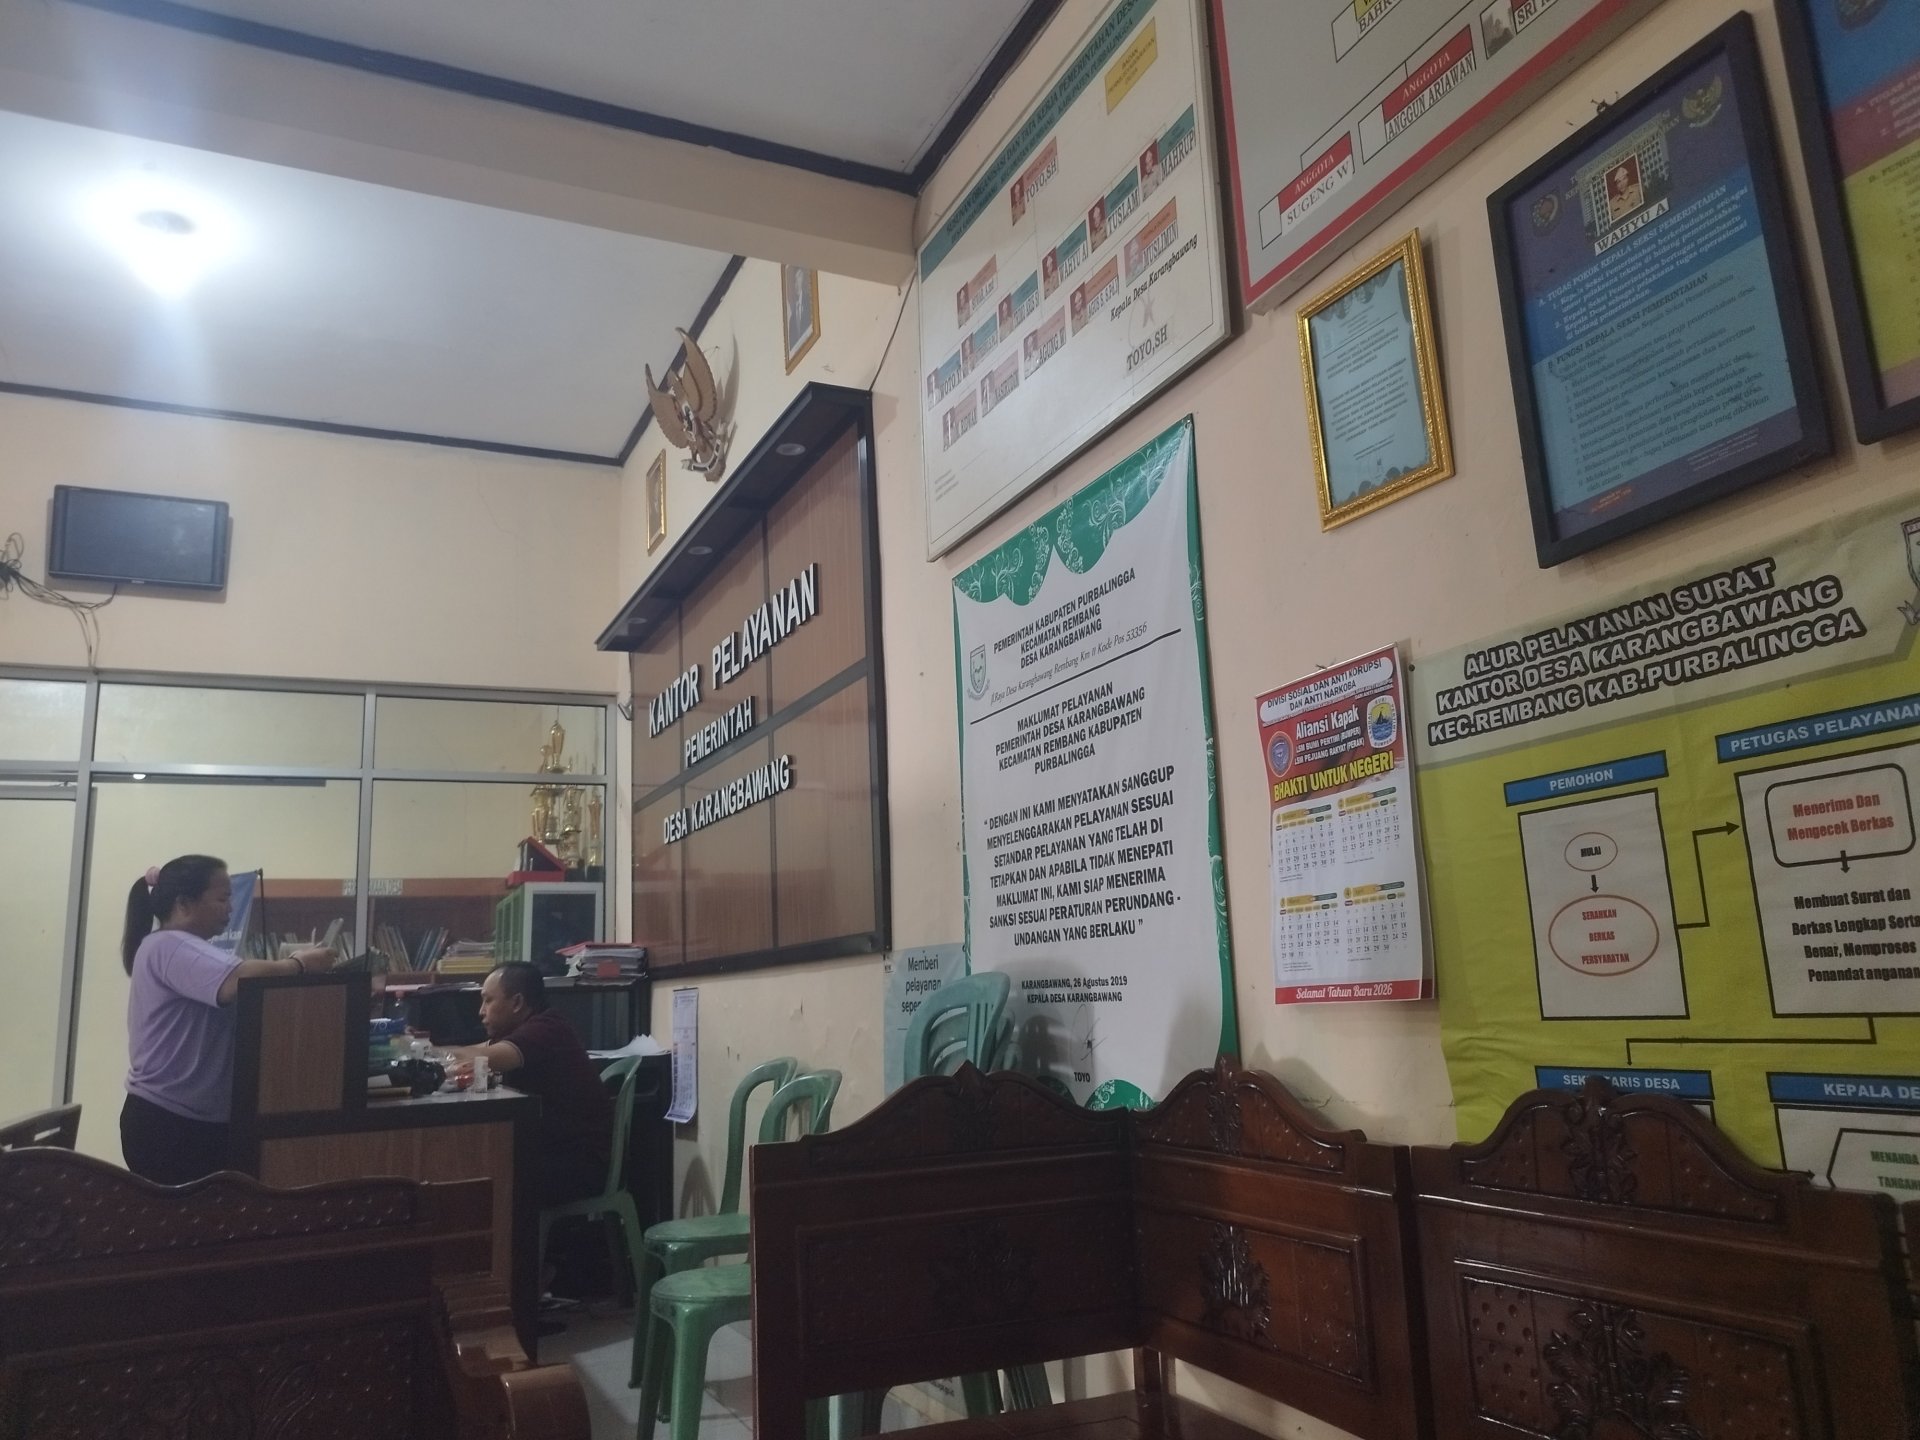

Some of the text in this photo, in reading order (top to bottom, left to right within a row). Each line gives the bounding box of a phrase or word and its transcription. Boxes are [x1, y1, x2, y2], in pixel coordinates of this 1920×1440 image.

[1401, 51, 1451, 99] ANGGOTA
[1387, 52, 1474, 140] ANGGUN ARIAWAN
[1294, 153, 1335, 195] ANGGOTA
[1286, 178, 1335, 226] SUGENG
[1597, 203, 1667, 251] WAHYU A
[1110, 233, 1198, 322] Kepala Desa Karangbawang
[1126, 324, 1168, 371] TOYO,SH
[994, 568, 1136, 654] PEMERINTAH KABUPATEN PURBALINGGA
[1020, 603, 1101, 654] KECAMATAN REMBANG
[1465, 561, 1774, 677] ALUR PELAYANAN SURAT
[649, 563, 818, 738] KANTOR PELAYANAN
[1020, 619, 1102, 669] DESA KARANGBAWANG
[1125, 621, 1148, 642] 53356
[1437, 578, 1840, 713] KANTOR DESA KARANGBAWANG
[1267, 659, 1382, 709] DIVISI SOSIAL DAN ANTI KORUPSI
[1289, 700, 1303, 711] DAN
[1304, 693, 1323, 706] ANTI
[1324, 680, 1357, 700] NARKOBA
[1430, 687, 1581, 744] KEC.REMBANG
[1587, 612, 1863, 709] KAB.PURBALINGGA
[995, 686, 1145, 756] PEMERINTAH DESA KARANGBAWANG
[1017, 681, 1113, 733] MAKLUMAT PELAYANAN
[1296, 715, 1329, 741] Aliansi
[1330, 704, 1360, 730] Kapak
[685, 696, 755, 768] PEMERINTAH
[998, 707, 1143, 772] KECAMATAN REMBANG KABUPATEN
[1730, 726, 1809, 753] PETUGAS
[1034, 743, 1096, 774] PURBALINGGA
[1274, 750, 1395, 802] BHAKTI UNTUK NEGERI
[663, 754, 792, 845] DESA KARANGBAWANG
[1019, 806, 1031, 821] INI
[1033, 800, 1056, 818] KAMI
[1057, 781, 1121, 810] MENYATAKAN
[1121, 765, 1175, 793] SANGGUP
[1549, 768, 1614, 792] PEMOHON
[986, 790, 1174, 850] MENYELENGGARAKAN PELAYANAN SESUAI
[1793, 794, 1881, 818] Menerima Dan
[993, 817, 1163, 868] SETANDAR PELAYANAN YANG TELAH DI
[1787, 816, 1895, 841] Mengecek Berkas
[990, 839, 1174, 889] TETAPKAN DAN APABILA TIDAK MENEPATI
[1580, 846, 1602, 858] MULAI
[996, 866, 1166, 907] MAKLUMAT INI, KAMI SIAP MENERIMA
[1794, 887, 1911, 910] Membuat Surat dan
[989, 889, 1174, 929] SANKSI SESUAI PERATURAN PERUNDANG
[1582, 908, 1617, 921] SERAHKAN
[1791, 921, 1833, 936] Berkas
[1834, 917, 1887, 933] Lengkap
[1014, 919, 1136, 947] UNDANGAN YANG BERLAKU
[1588, 931, 1615, 942] BERKAS
[1803, 941, 1917, 958] Benar, Memproses
[907, 955, 939, 971] Memberi
[1581, 953, 1630, 965] PERSYARATAN
[905, 977, 942, 995] pelayanan
[1021, 975, 1128, 992] KARANGBAWANG, 26 Agustus 2019
[1026, 991, 1123, 1005] KEPALA DESA KARANGBAWANG
[1296, 983, 1393, 999] Selamat Tahun Baru 2026
[1074, 1072, 1091, 1083] TOYO
[1644, 1077, 1681, 1090] DESA
[1823, 1083, 1893, 1098] KEPALA
[1870, 1150, 1920, 1165] MENANDA
